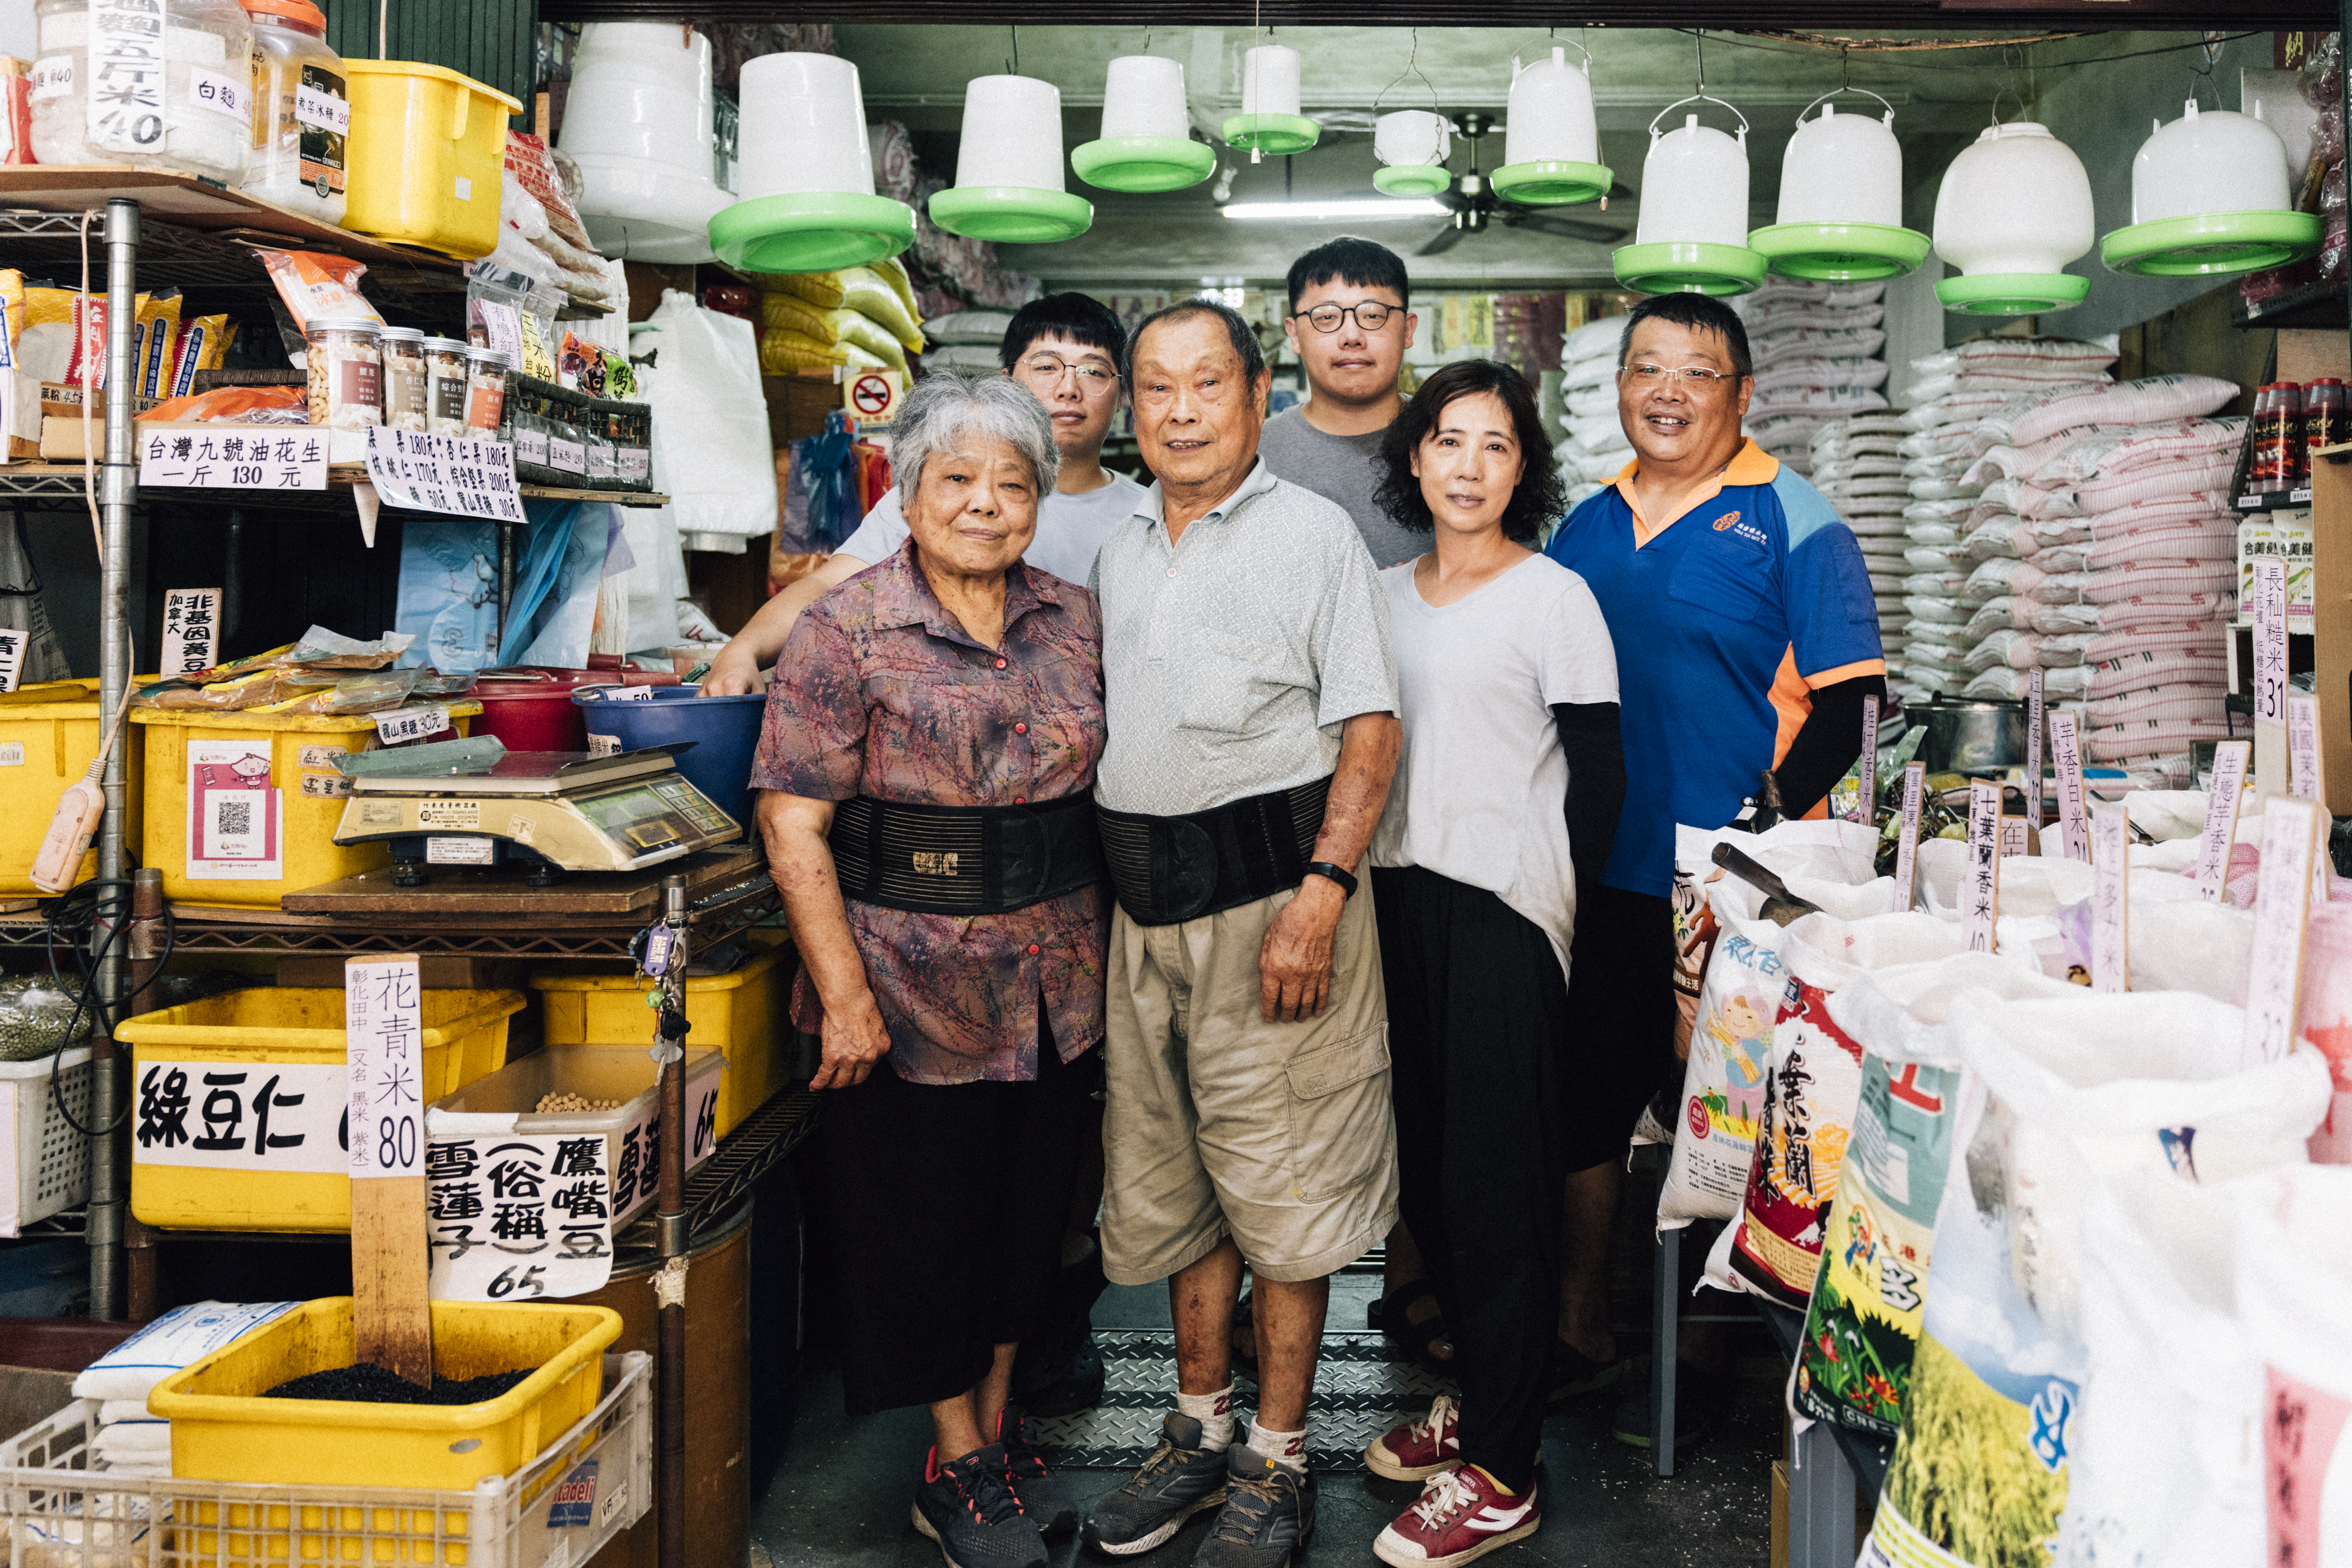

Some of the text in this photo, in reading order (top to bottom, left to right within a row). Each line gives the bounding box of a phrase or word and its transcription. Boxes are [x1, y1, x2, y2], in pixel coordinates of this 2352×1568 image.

[338, 112, 349, 126] 20
[441, 382, 465, 393] 綜合堅
[149, 435, 322, 464] 台灣九號油花生
[162, 465, 301, 487] 一斤 130 元
[168, 593, 183, 634] 加拿大
[180, 594, 214, 673] 非基因黃豆
[2264, 566, 2284, 673] 長秈糙米
[2266, 678, 2284, 720] 31
[2060, 720, 2086, 834] 芋香白米
[1973, 790, 1997, 922] 七葉蘭香米
[351, 969, 369, 1032] 彰化田中
[375, 968, 419, 1107] 花青米
[136, 1065, 305, 1155] 綠豆仁
[378, 1115, 416, 1168] 80
[425, 1139, 486, 1260] 雪蓮子
[550, 1137, 610, 1259] 鷹嘴豆
[487, 1265, 547, 1298] 65
